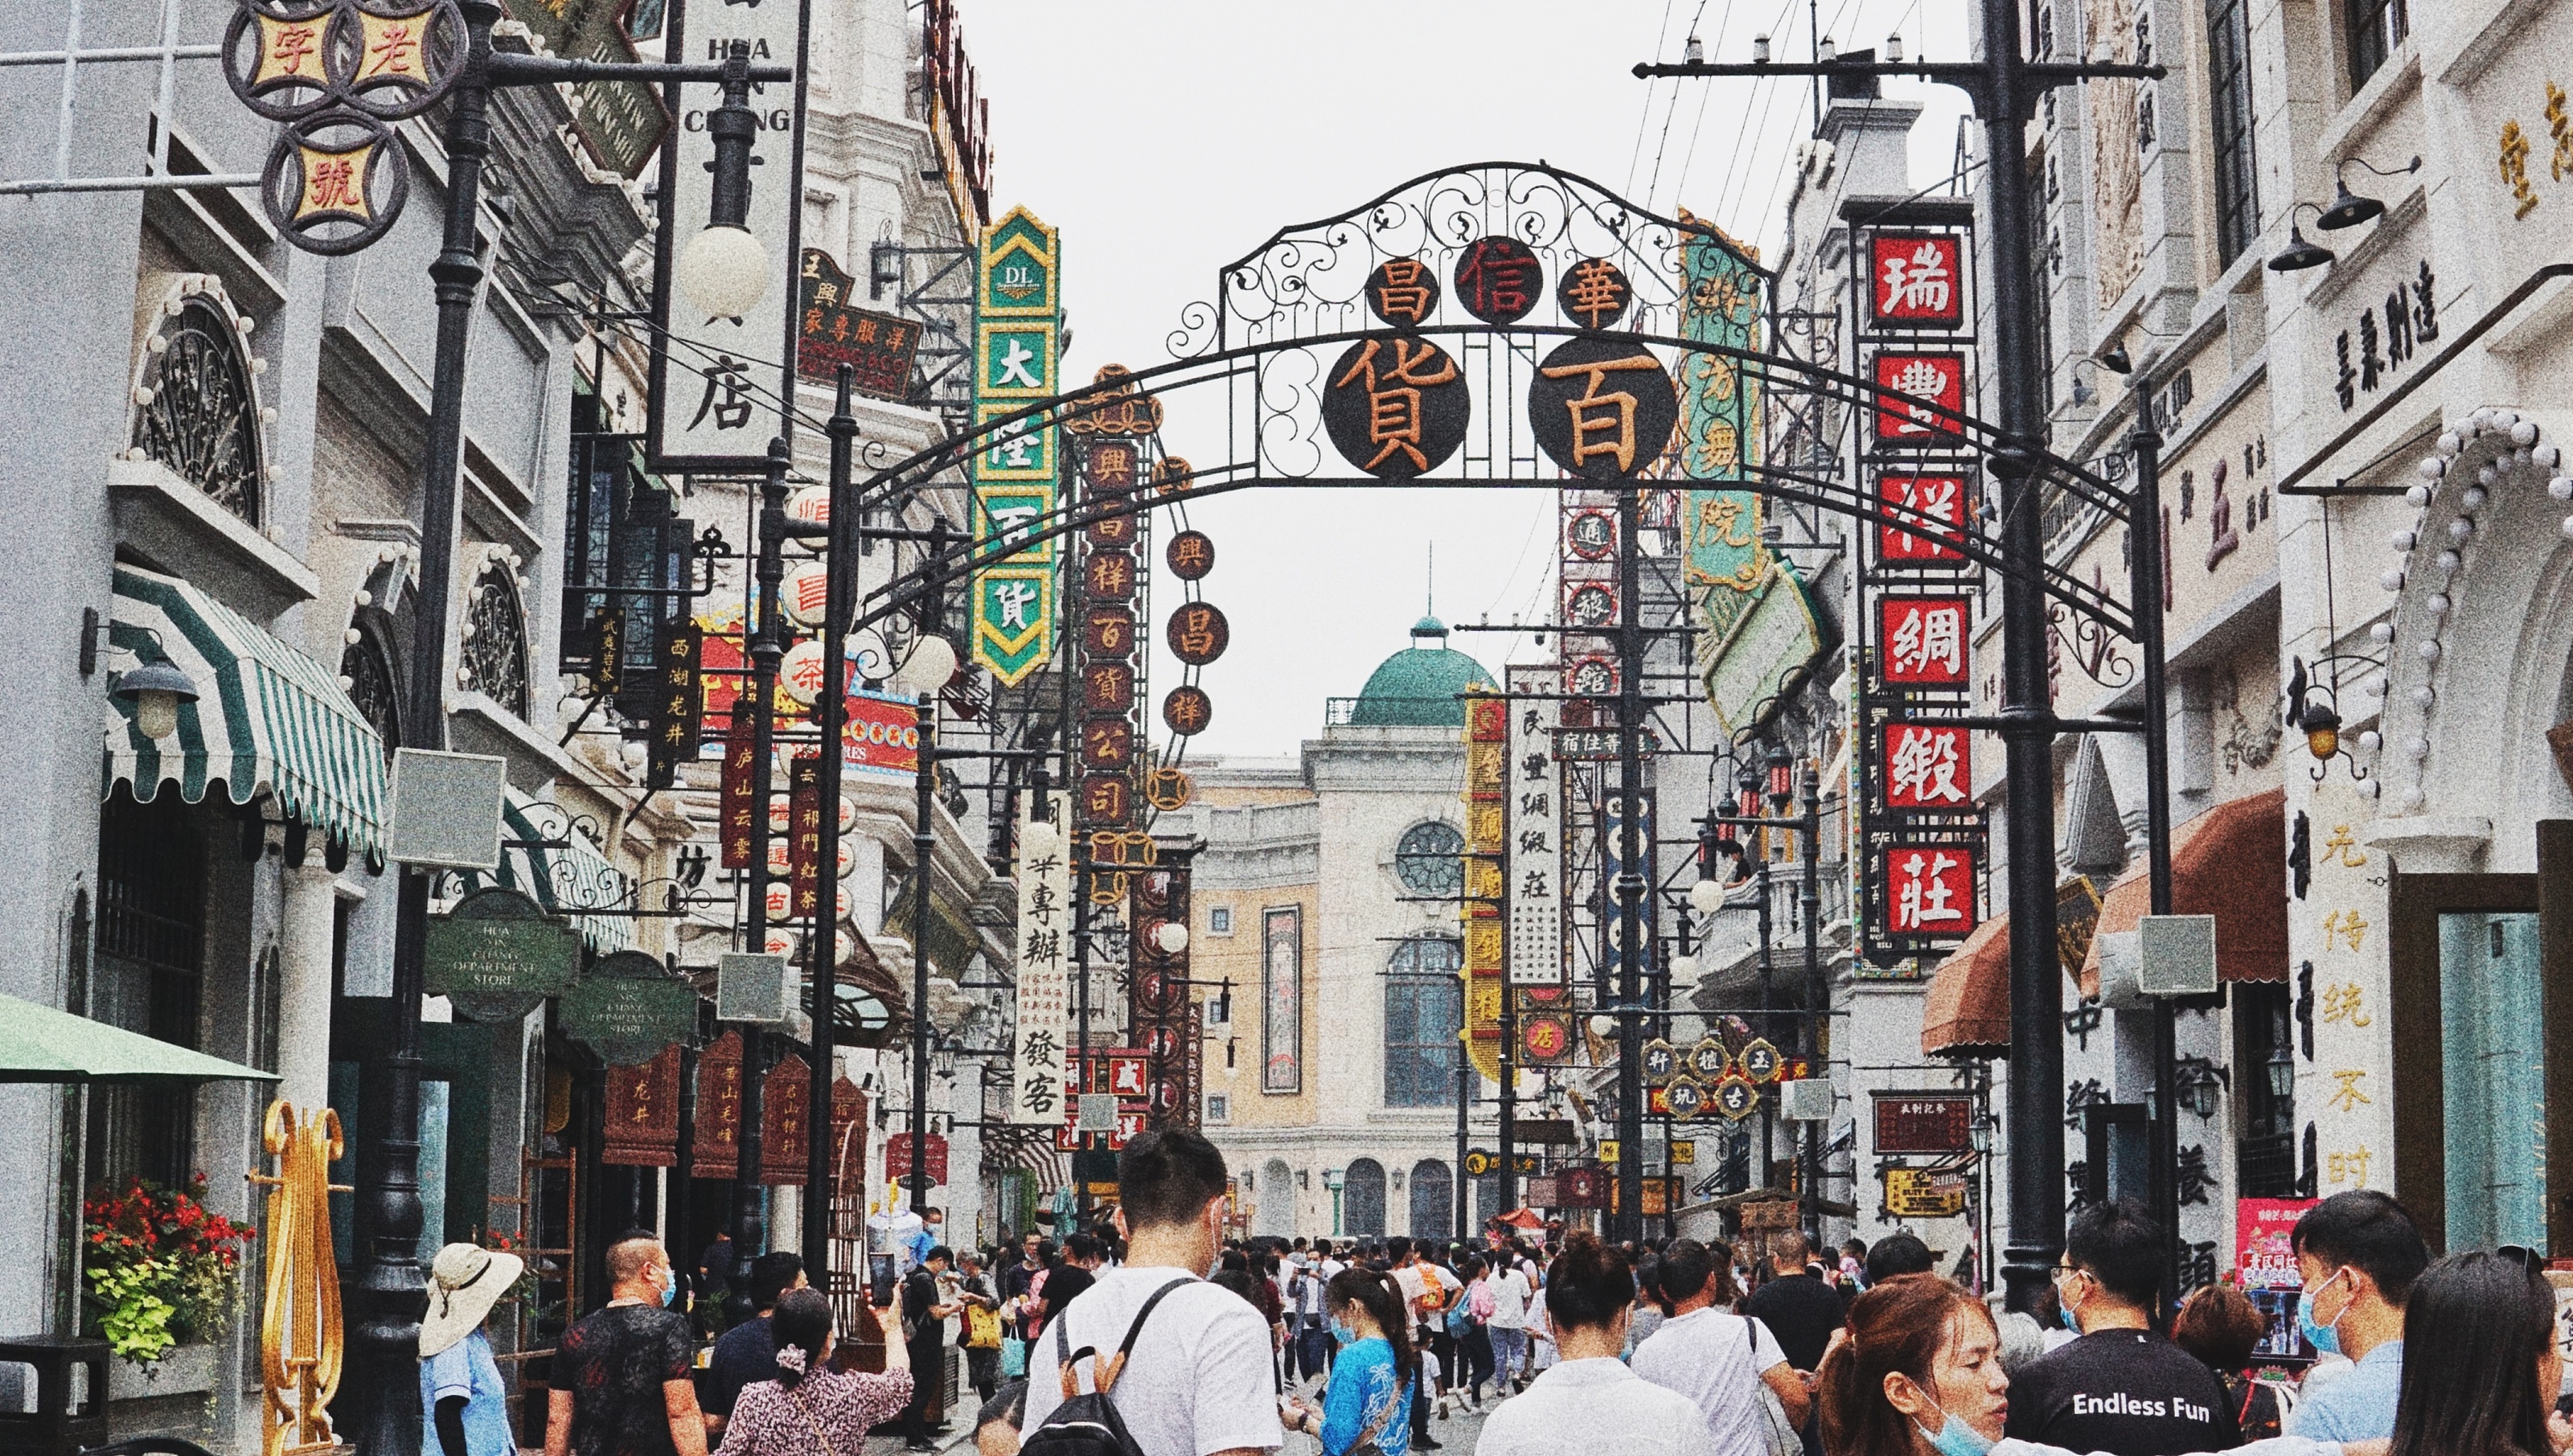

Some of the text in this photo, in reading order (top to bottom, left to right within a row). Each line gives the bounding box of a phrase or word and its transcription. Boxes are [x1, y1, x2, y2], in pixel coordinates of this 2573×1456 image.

[708, 39, 770, 59] HA
[310, 159, 359, 208] 號
[1005, 267, 1033, 283] DL
[666, 640, 689, 746] 西湖龙井
[732, 749, 752, 859] 庐山云雾
[454, 962, 535, 973] DEPARTMENT
[474, 975, 512, 985] STORE
[2073, 1393, 2209, 1423] Endless Fun
